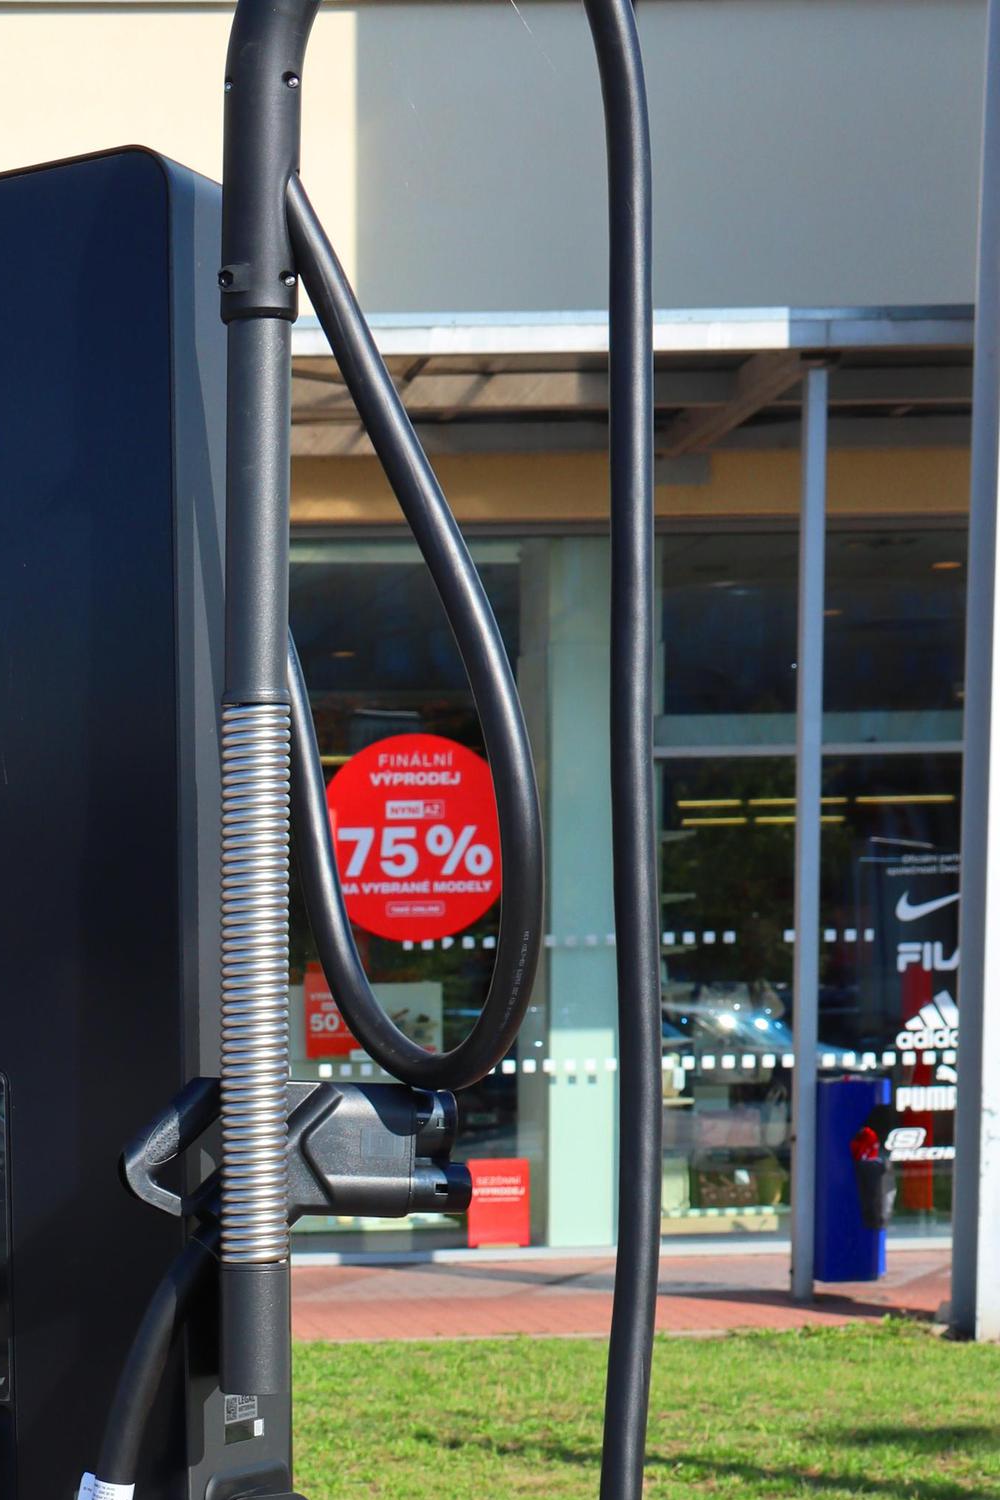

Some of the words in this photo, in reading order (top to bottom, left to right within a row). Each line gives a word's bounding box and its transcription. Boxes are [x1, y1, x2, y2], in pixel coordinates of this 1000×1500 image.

[378, 751, 453, 768] FINÁLNÍ
[370, 770, 460, 787] VÝPRODEJ
[341, 882, 360, 895] NA
[362, 879, 431, 895] VYBRANÉ
[433, 880, 492, 894] MODELY
